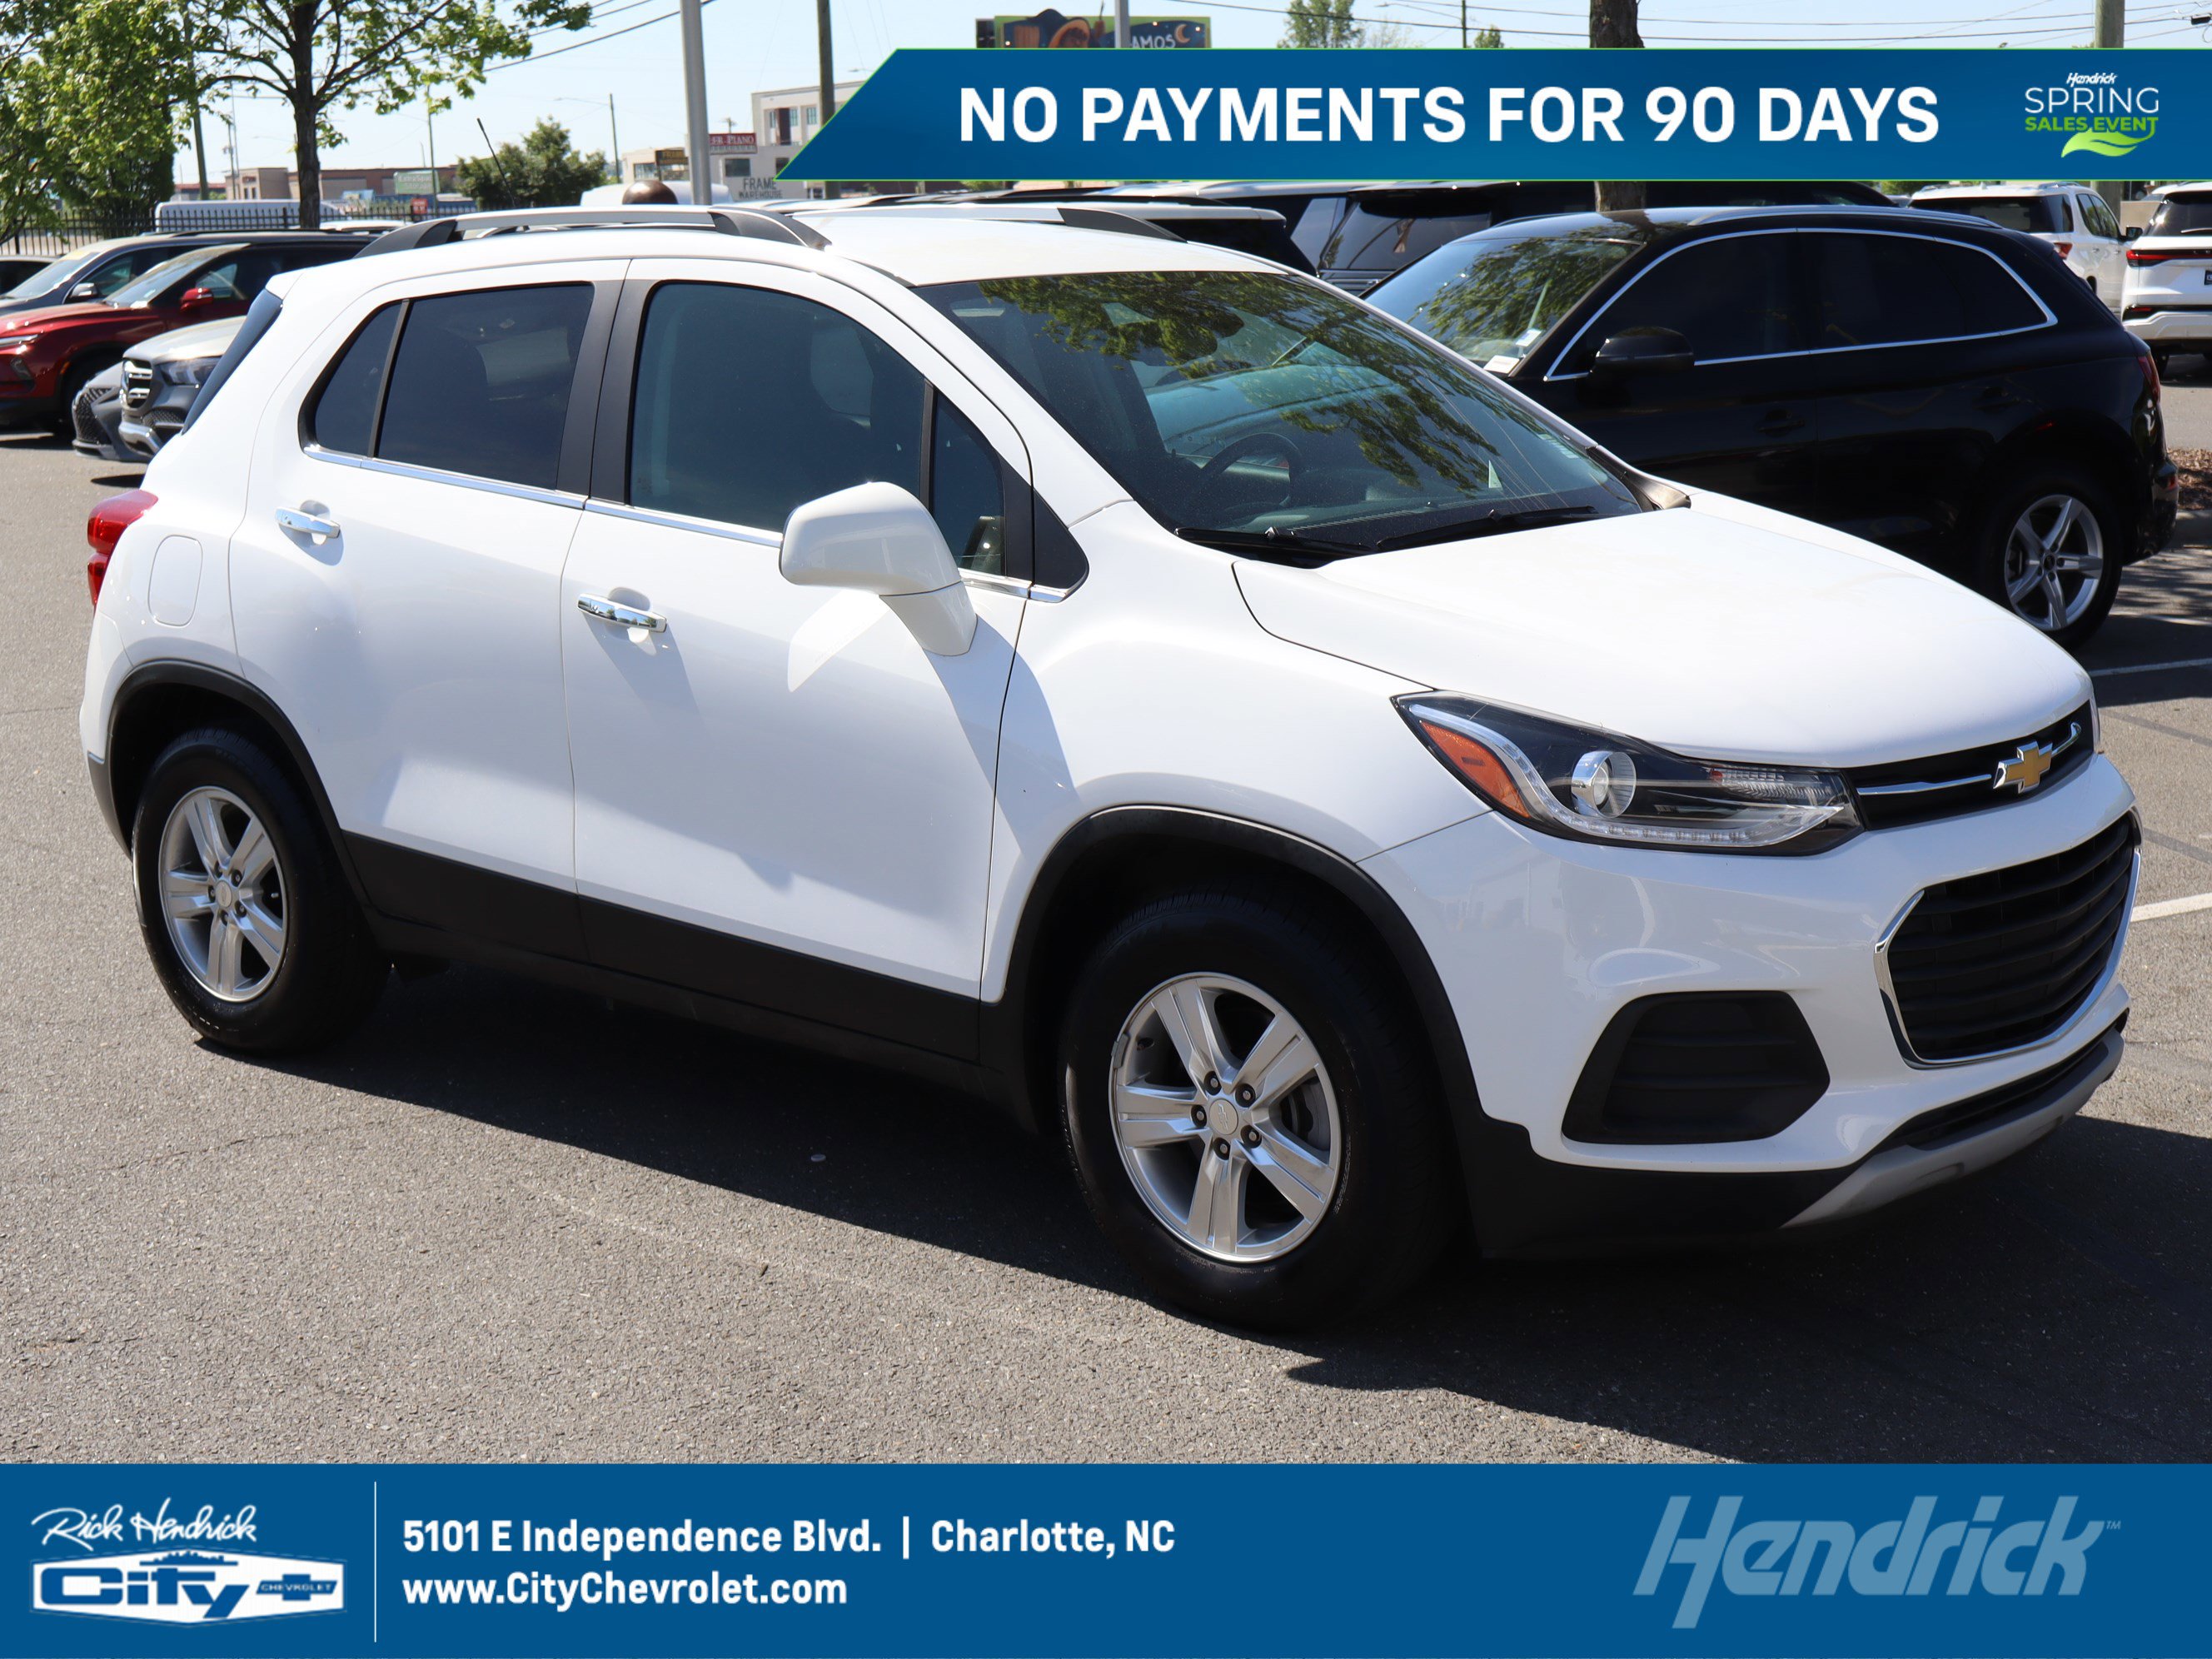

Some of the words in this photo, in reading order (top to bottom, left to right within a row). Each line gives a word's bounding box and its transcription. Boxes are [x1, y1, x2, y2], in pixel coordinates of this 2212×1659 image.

[1131, 34, 1176, 48] AMOS
[727, 135, 755, 145] PIANO
[743, 177, 776, 190] FRAME
[739, 190, 783, 199] WAREHOUSE
